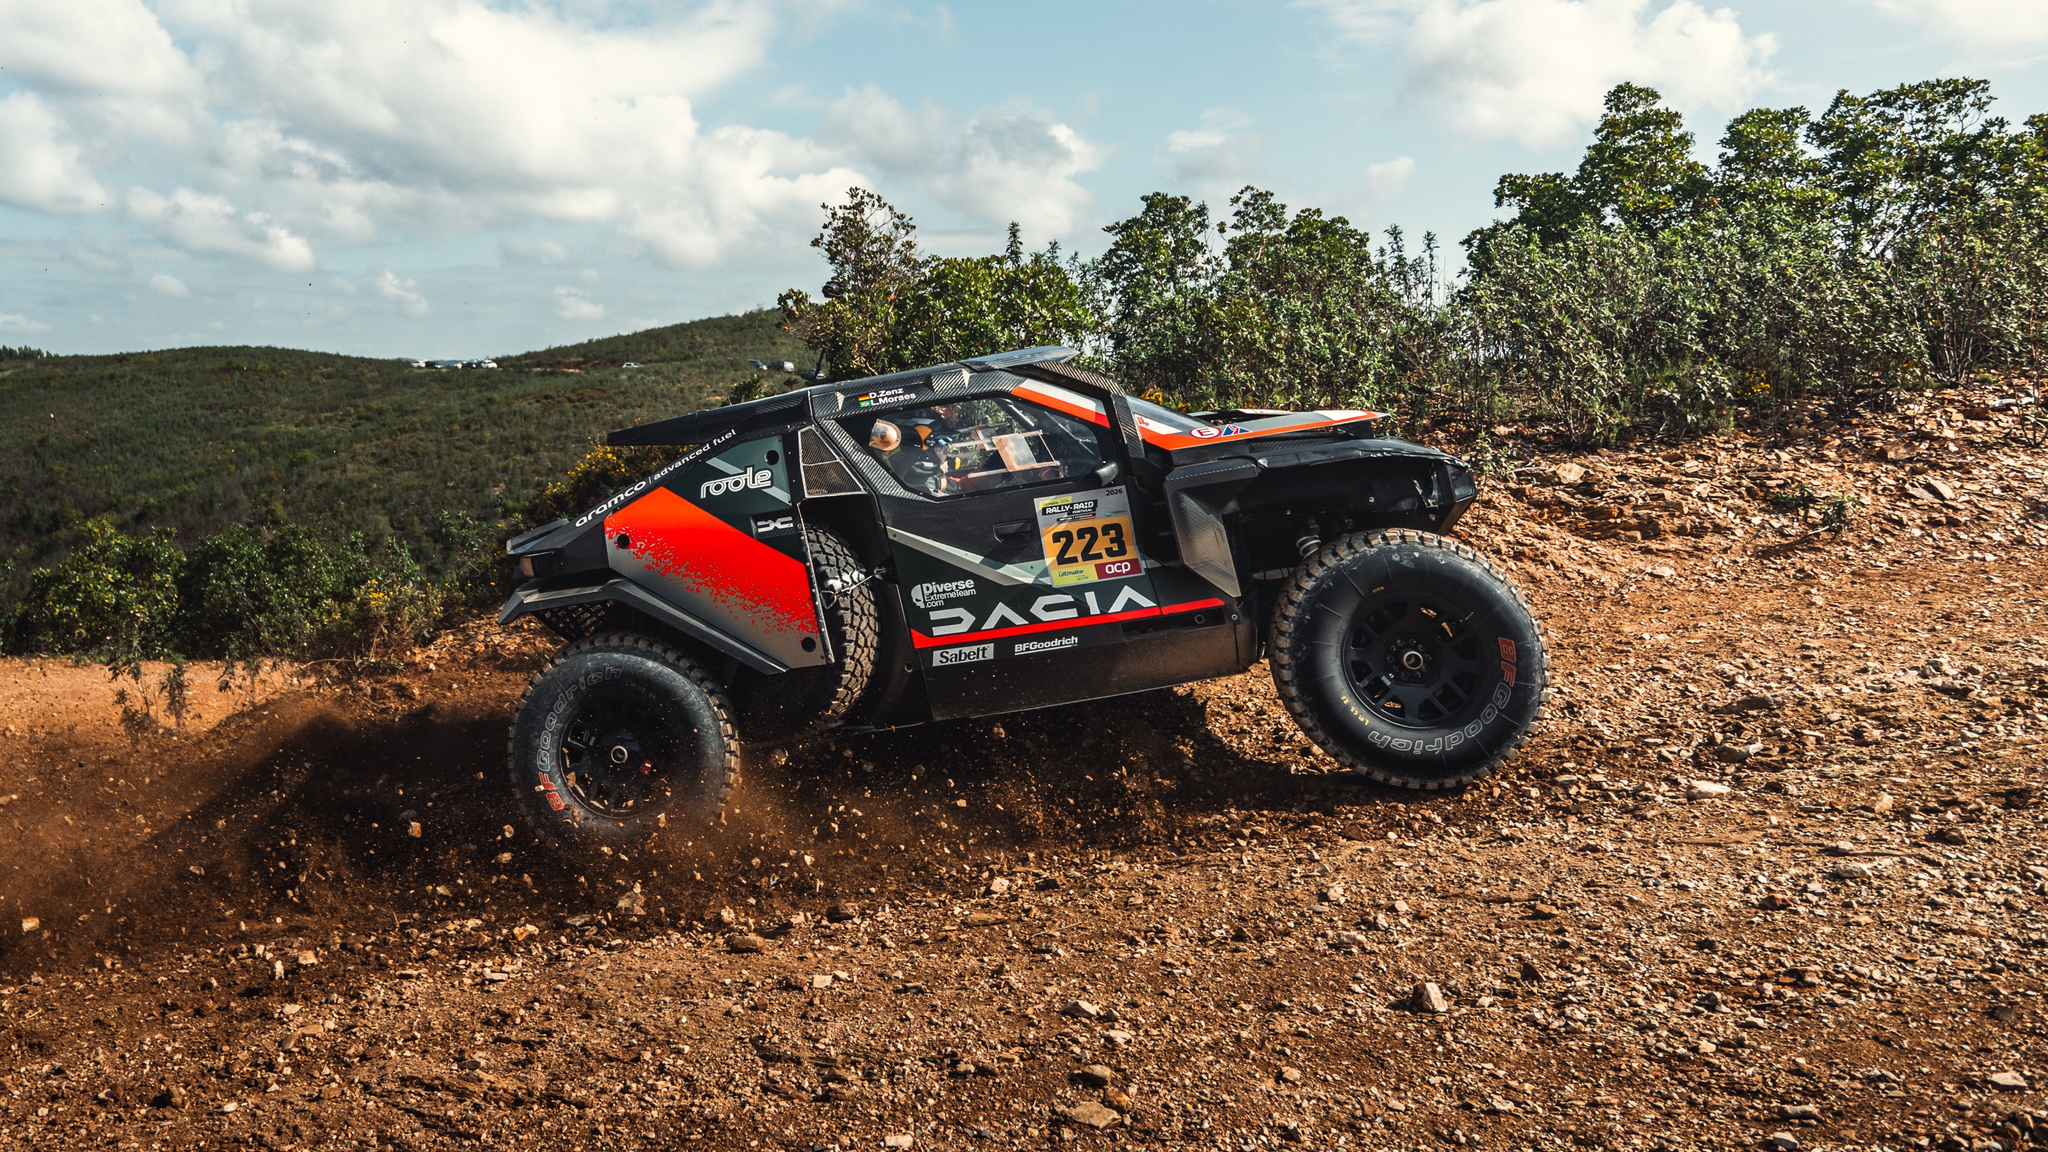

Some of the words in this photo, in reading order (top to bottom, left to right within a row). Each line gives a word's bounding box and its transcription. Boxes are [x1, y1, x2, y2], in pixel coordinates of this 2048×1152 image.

[869, 388, 904, 399] D.Zenz
[870, 393, 917, 406] L.Moraes
[575, 480, 647, 528] aramco
[653, 443, 711, 481] advanced
[713, 428, 737, 446] fuel
[1105, 488, 1123, 496] 2026
[1045, 501, 1094, 514] RALLY-RAID
[1052, 523, 1127, 566] 223
[1105, 562, 1131, 574] acp
[922, 579, 975, 594] Diverse
[924, 588, 977, 602] ExtremeTeam
[926, 600, 944, 608] .com
[929, 585, 1157, 636] DACIA
[1014, 636, 1078, 652] BFGoodrich
[938, 647, 988, 664] Sabelt
[1368, 637, 1516, 755] BFGoodrich
